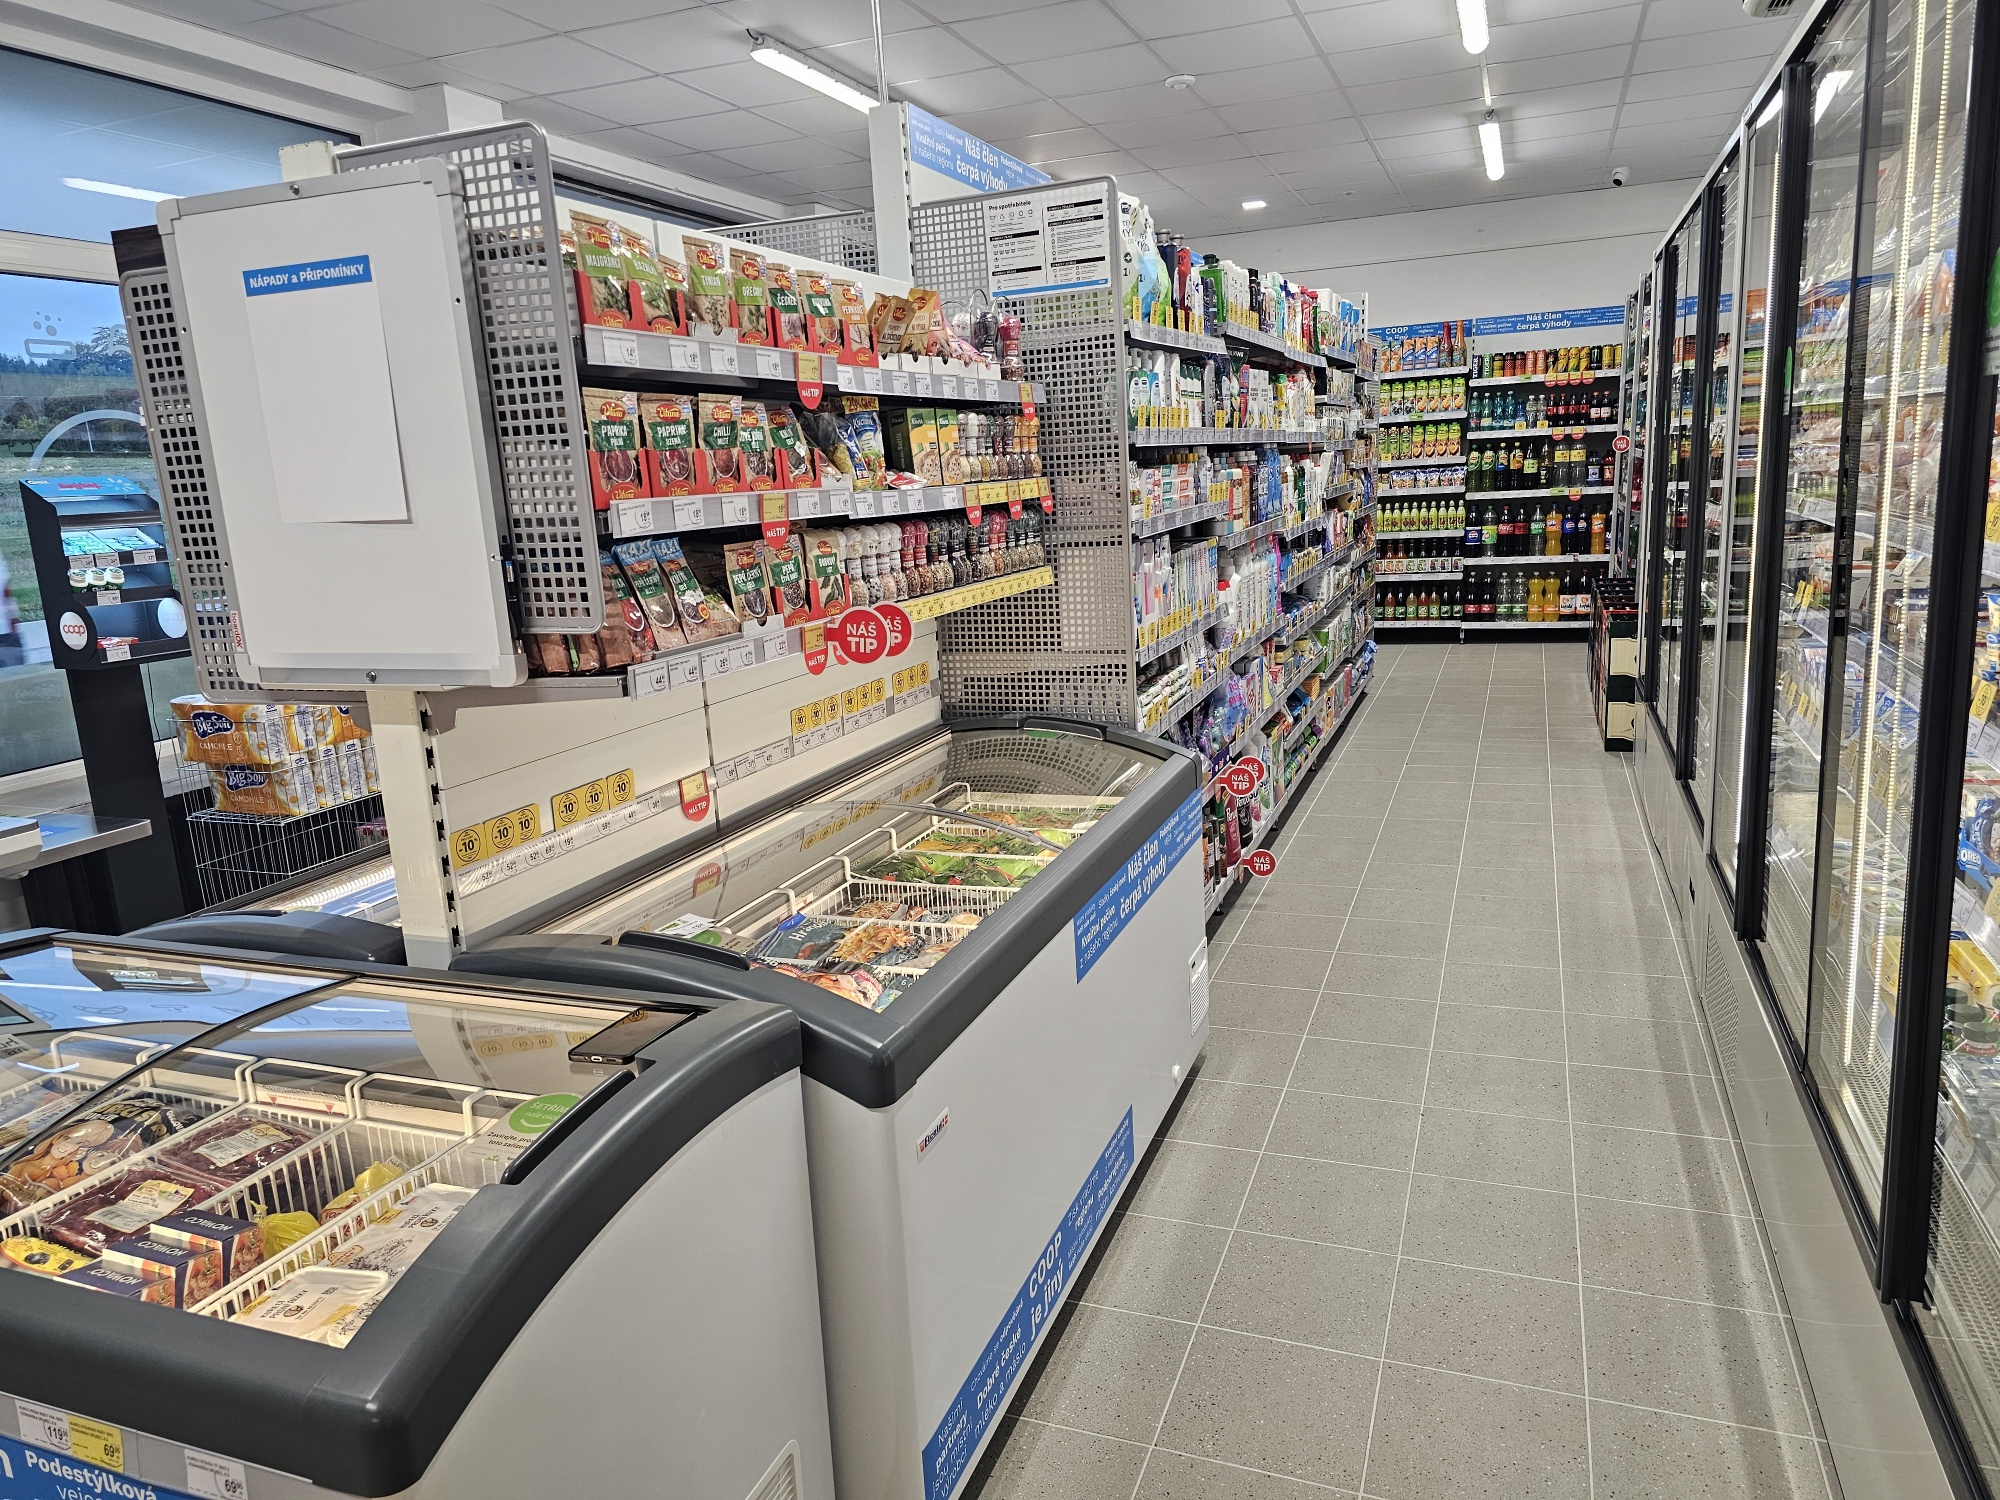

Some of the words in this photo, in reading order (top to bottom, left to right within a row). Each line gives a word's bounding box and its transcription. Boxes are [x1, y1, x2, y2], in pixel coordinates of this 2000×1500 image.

[915, 131, 935, 148] Kvalitní
[965, 138, 981, 160] Náš
[982, 144, 999, 169] člen
[956, 154, 980, 183] čerpá
[981, 170, 1008, 191] výhody
[998, 200, 1032, 209] spotřebitele
[249, 272, 289, 290] NÁPADY
[291, 274, 298, 284] a
[299, 263, 365, 285] PŘIPOMÍNKY
[1516, 321, 1540, 330] čerpá
[1542, 319, 1572, 330] výhody
[1526, 314, 1542, 322] Náš
[1544, 312, 1562, 320] člen
[1385, 326, 1408, 334] COOP
[811, 388, 820, 397] TIP
[602, 424, 628, 437] PAPRIKA
[766, 529, 776, 538] NÁŠ
[776, 528, 786, 536] TIP
[617, 540, 652, 556] MAXI
[63, 624, 86, 636] coop
[231, 612, 244, 649] boardOK
[846, 621, 877, 638] NÁŠ
[886, 616, 902, 632] ÁŠ
[847, 636, 878, 654] TIP
[890, 632, 902, 648] IP
[816, 654, 825, 664] TIP
[1231, 772, 1249, 782] NÁŠ
[1232, 782, 1250, 790] TIP
[698, 802, 707, 811] TIP
[1128, 848, 1142, 883] Náš
[1143, 838, 1159, 866] člen
[1253, 856, 1270, 864] NÁŠ
[1960, 850, 1981, 864] OREO
[1254, 864, 1270, 872] TIP
[1120, 877, 1143, 920] čerpá
[1142, 854, 1168, 895] výhody
[1081, 917, 1100, 950] Kvalitní
[1100, 905, 1115, 930] pečivo
[1084, 935, 1102, 964] našeho
[1102, 917, 1119, 943] regionu
[525, 1111, 542, 1119] naše
[530, 1100, 570, 1114] ŠETŘÍM
[488, 1140, 502, 1148] toto
[502, 1142, 530, 1150] zařízen
[1067, 1202, 1080, 1227] Zisk
[1080, 1170, 1100, 1206] vracíme
[1074, 1194, 1094, 1232] regionu
[1028, 1230, 1063, 1299] COOP
[1030, 1302, 1042, 1342] je
[1043, 1260, 1064, 1318] jiný
[970, 1352, 994, 1392] Chováme
[993, 1341, 1000, 1354] se
[977, 1361, 1000, 1410] Dobré
[1001, 1324, 1022, 1367] české
[974, 1392, 998, 1439] mléko
[999, 1382, 1005, 1394] a
[1004, 1342, 1027, 1384] máslo
[938, 1397, 964, 1448] Našimi
[936, 1410, 968, 1474] partnery
[932, 1462, 949, 1500] jsou
[950, 1418, 974, 1464] místní
[24, 1450, 157, 1500] Podestýlková
[940, 1445, 968, 1498] výrobci
